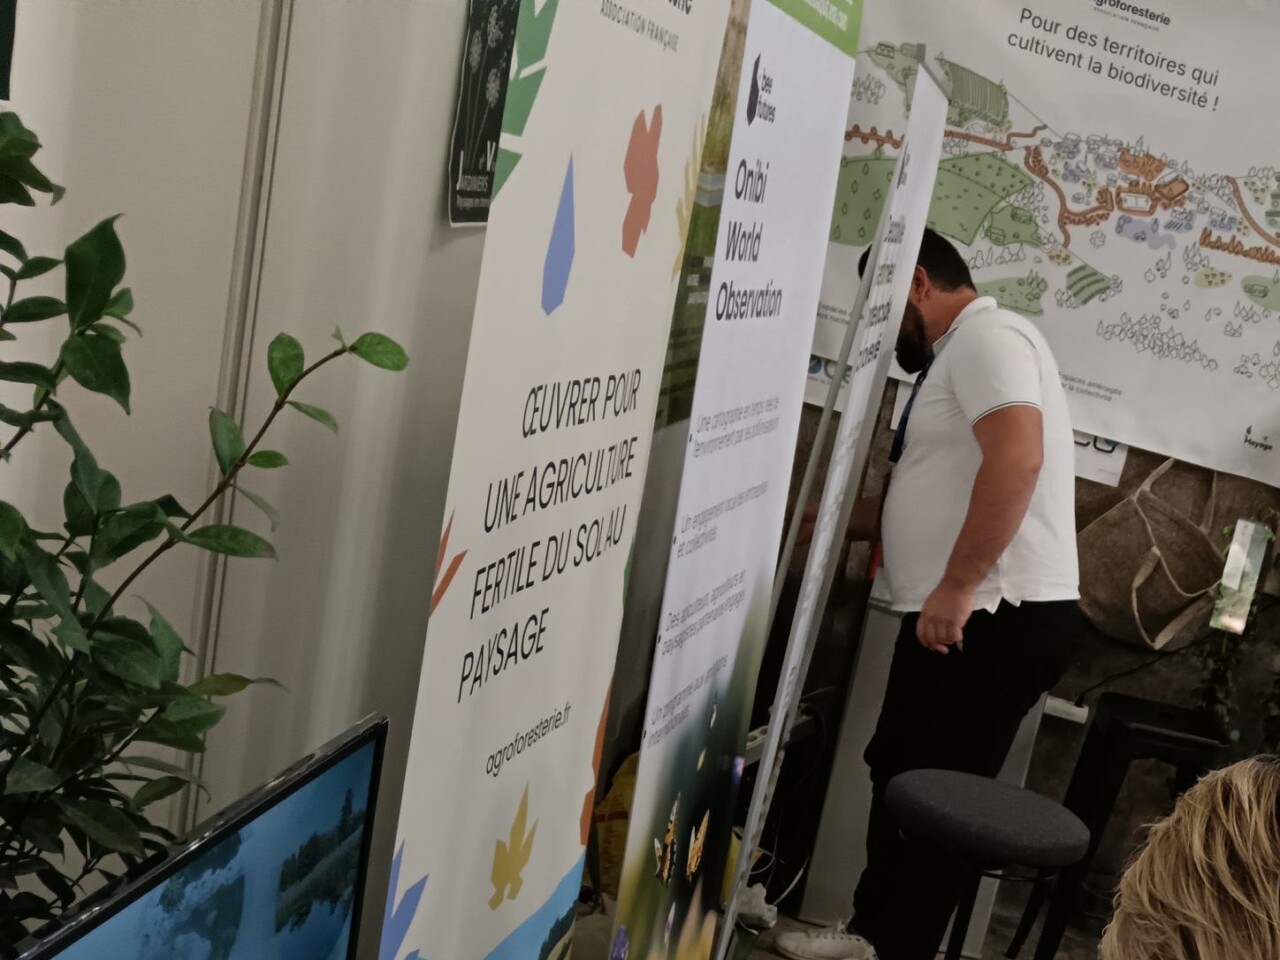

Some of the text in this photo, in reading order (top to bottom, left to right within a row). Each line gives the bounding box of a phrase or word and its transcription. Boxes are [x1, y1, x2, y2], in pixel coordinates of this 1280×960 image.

[761, 68, 773, 92] bee
[1007, 31, 1083, 70] cultivent
[1087, 55, 1102, 75] la
[1107, 61, 1208, 108] biodiversité
[1019, 8, 1220, 87] Pour des territoires qui
[735, 158, 769, 205] Onibi
[725, 220, 763, 263] World
[714, 280, 783, 321] Observation
[523, 369, 642, 439] ŒUVRER POUR
[484, 436, 639, 533] UNE AGRICULTURE
[470, 504, 628, 620] FERTILE DU SOL AU
[457, 608, 550, 704] PAYSAGE
[486, 701, 571, 778] agroforesterie.fr
